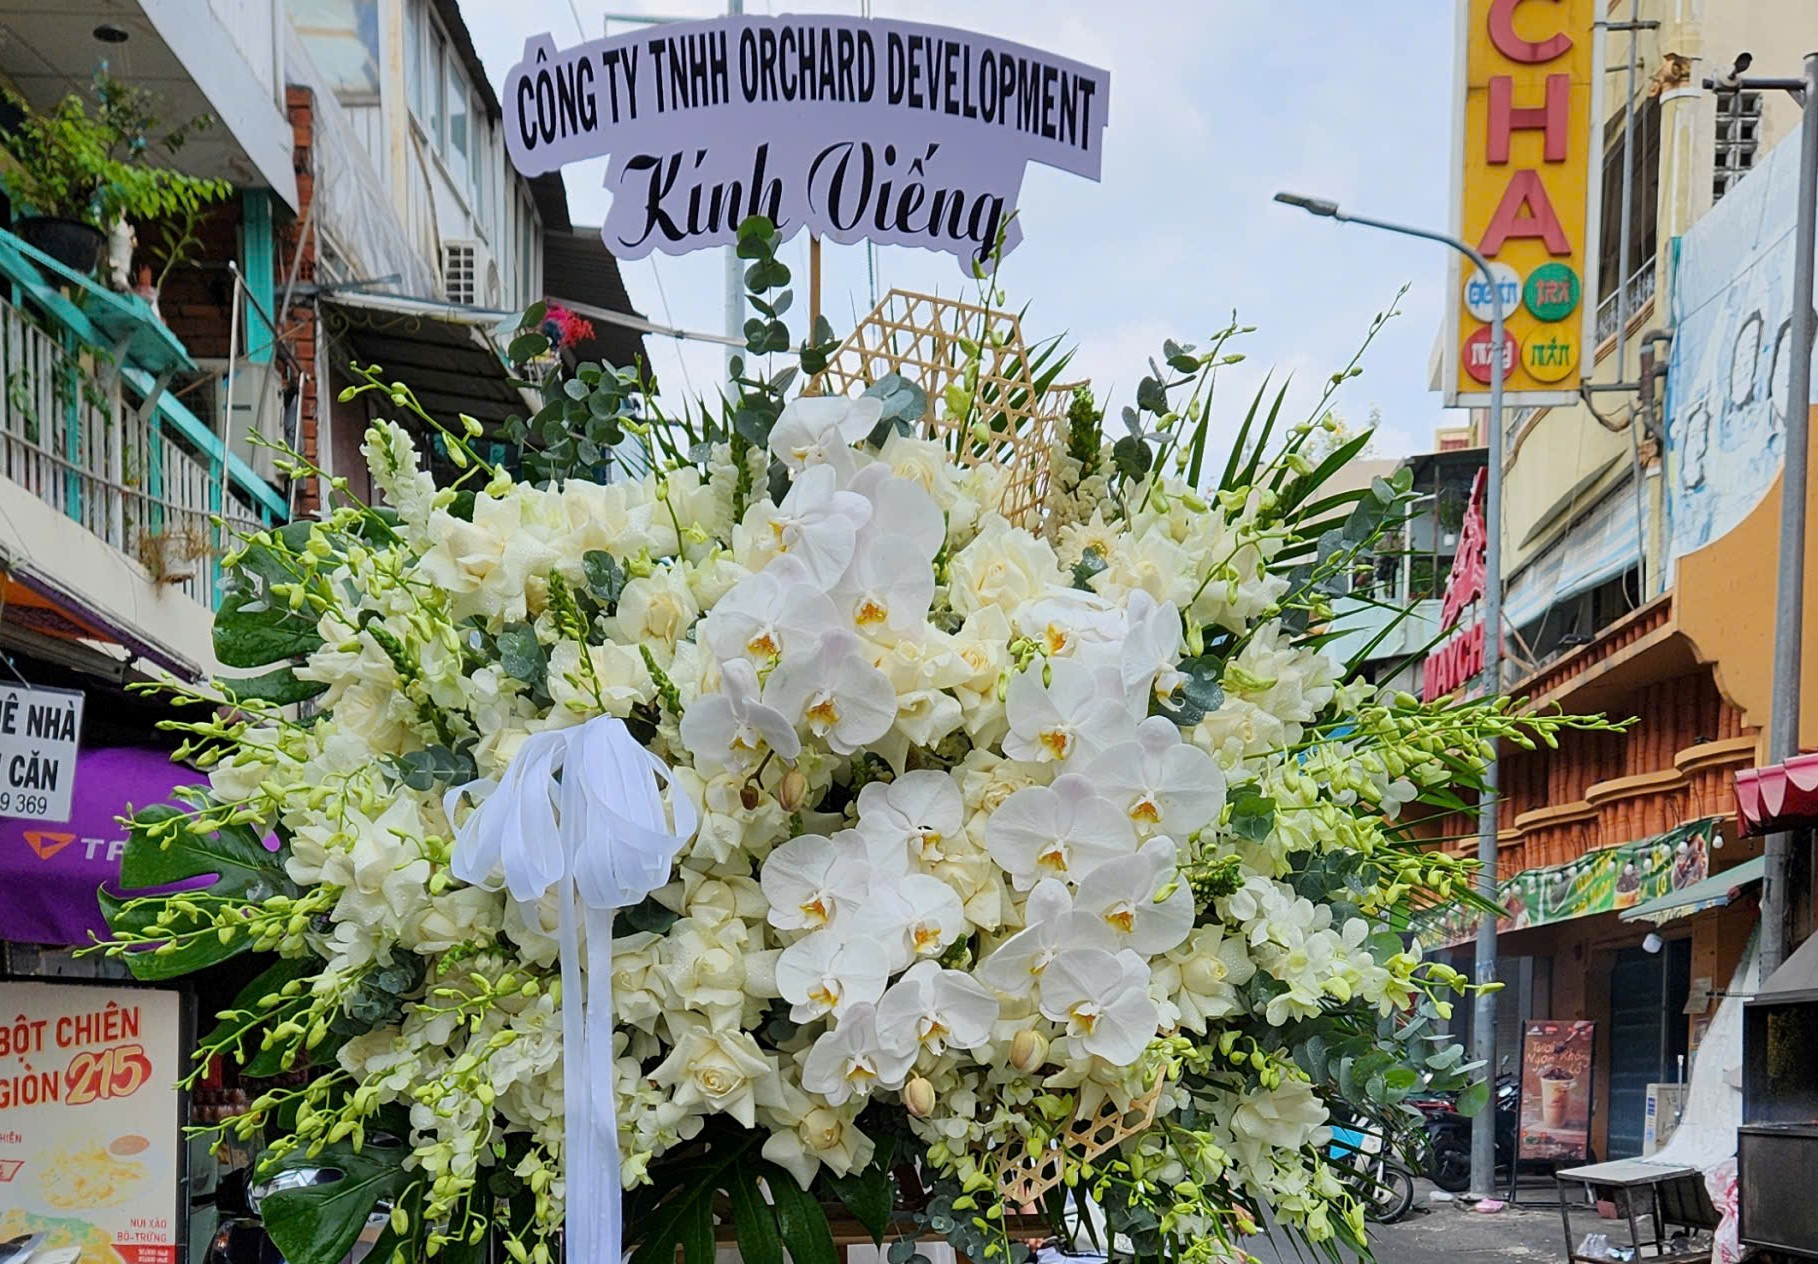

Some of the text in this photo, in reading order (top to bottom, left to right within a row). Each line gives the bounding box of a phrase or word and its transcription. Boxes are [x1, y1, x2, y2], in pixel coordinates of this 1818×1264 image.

[517, 26, 1097, 151] CÔNG TY TNHH ORCHARD DEVELOPMENT
[1477, 0, 1573, 256] CHA
[617, 142, 1006, 264] Kính Viếng
[1423, 619, 1504, 704] MAYCH
[26, 700, 76, 743] NHÀ
[9, 750, 59, 792] CĂN
[15, 794, 47, 815] 369
[56, 1000, 139, 1048] CHIÊN
[65, 1044, 146, 1105] 215
